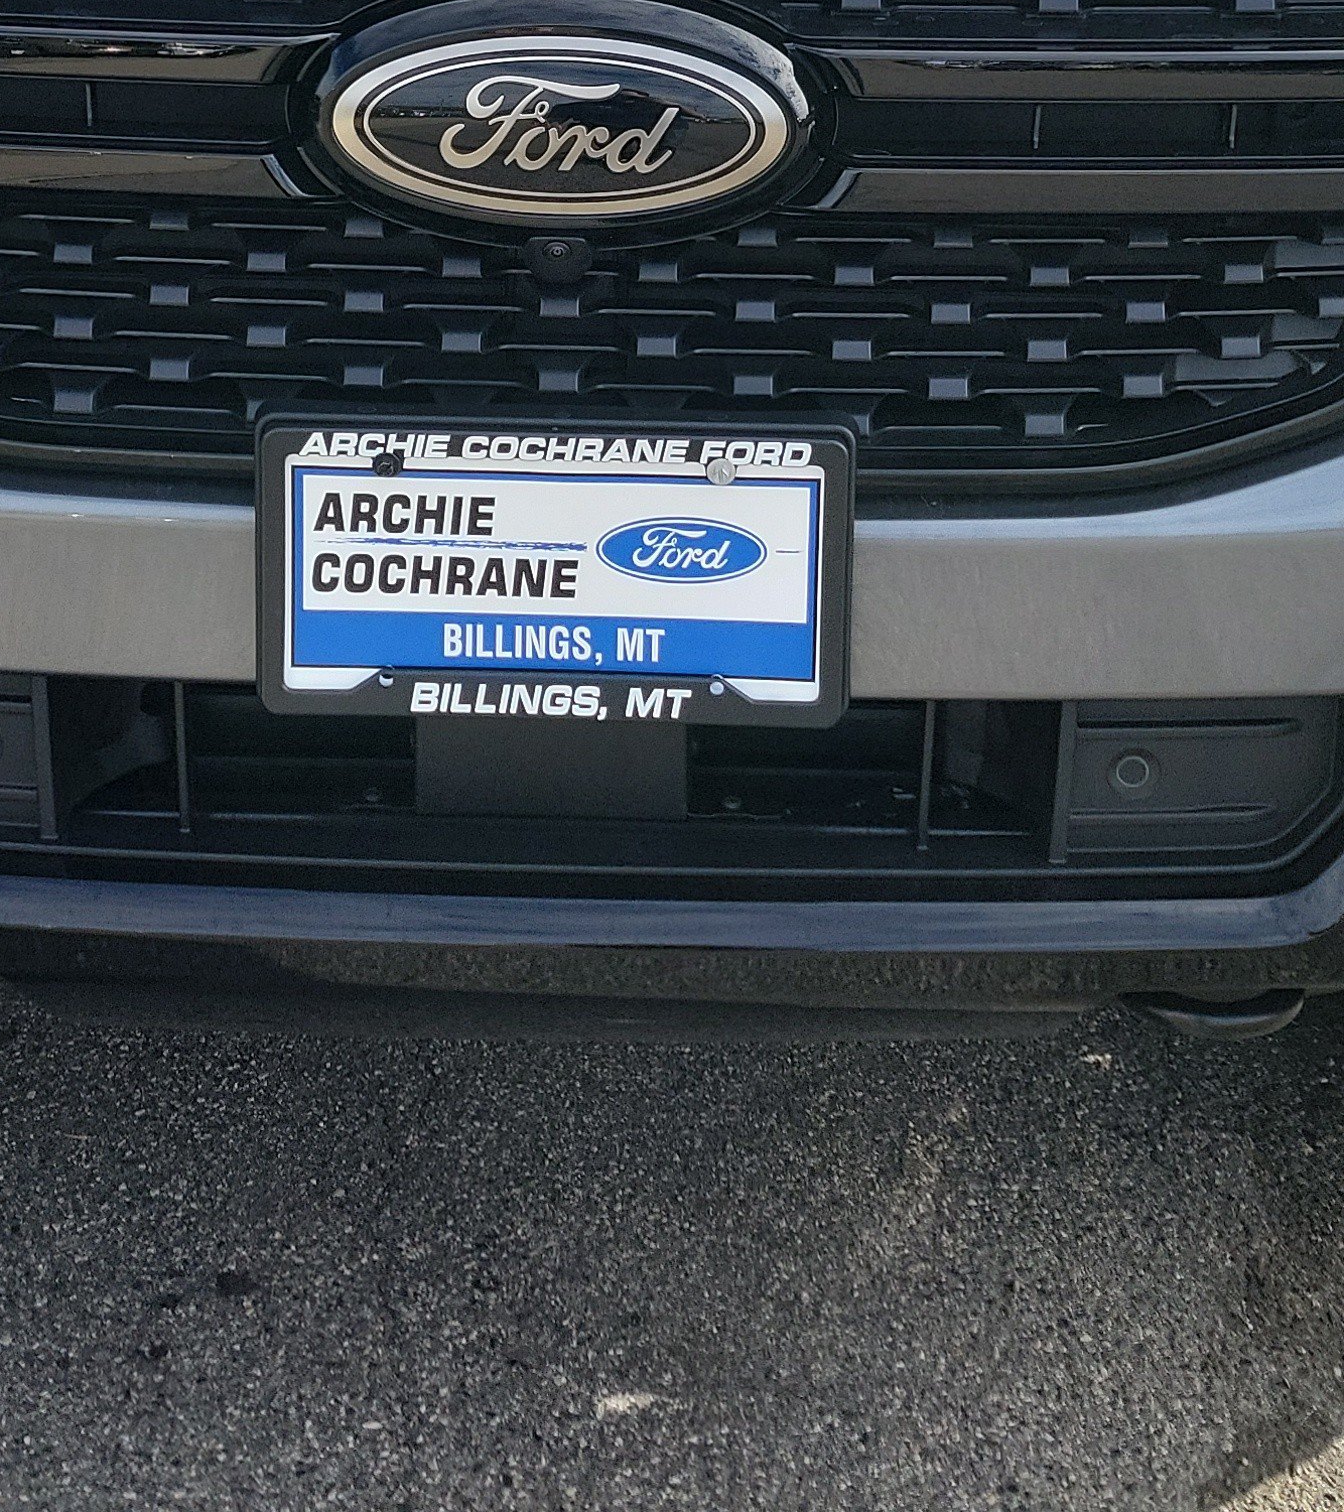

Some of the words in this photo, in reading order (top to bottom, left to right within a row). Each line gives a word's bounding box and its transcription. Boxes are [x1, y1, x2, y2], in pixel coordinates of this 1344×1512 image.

[439, 75, 679, 174] Ford
[299, 431, 451, 459] ARCHIE
[461, 436, 689, 465] COCHRANE
[699, 439, 812, 468] FORD
[313, 492, 497, 537] ARCHIE
[631, 526, 732, 570] Ford
[312, 552, 580, 600] COCHRANE
[443, 623, 603, 667] BILLINGS,
[616, 627, 666, 664] MT
[410, 681, 608, 722] BILLINGS,
[625, 687, 693, 720] MT
